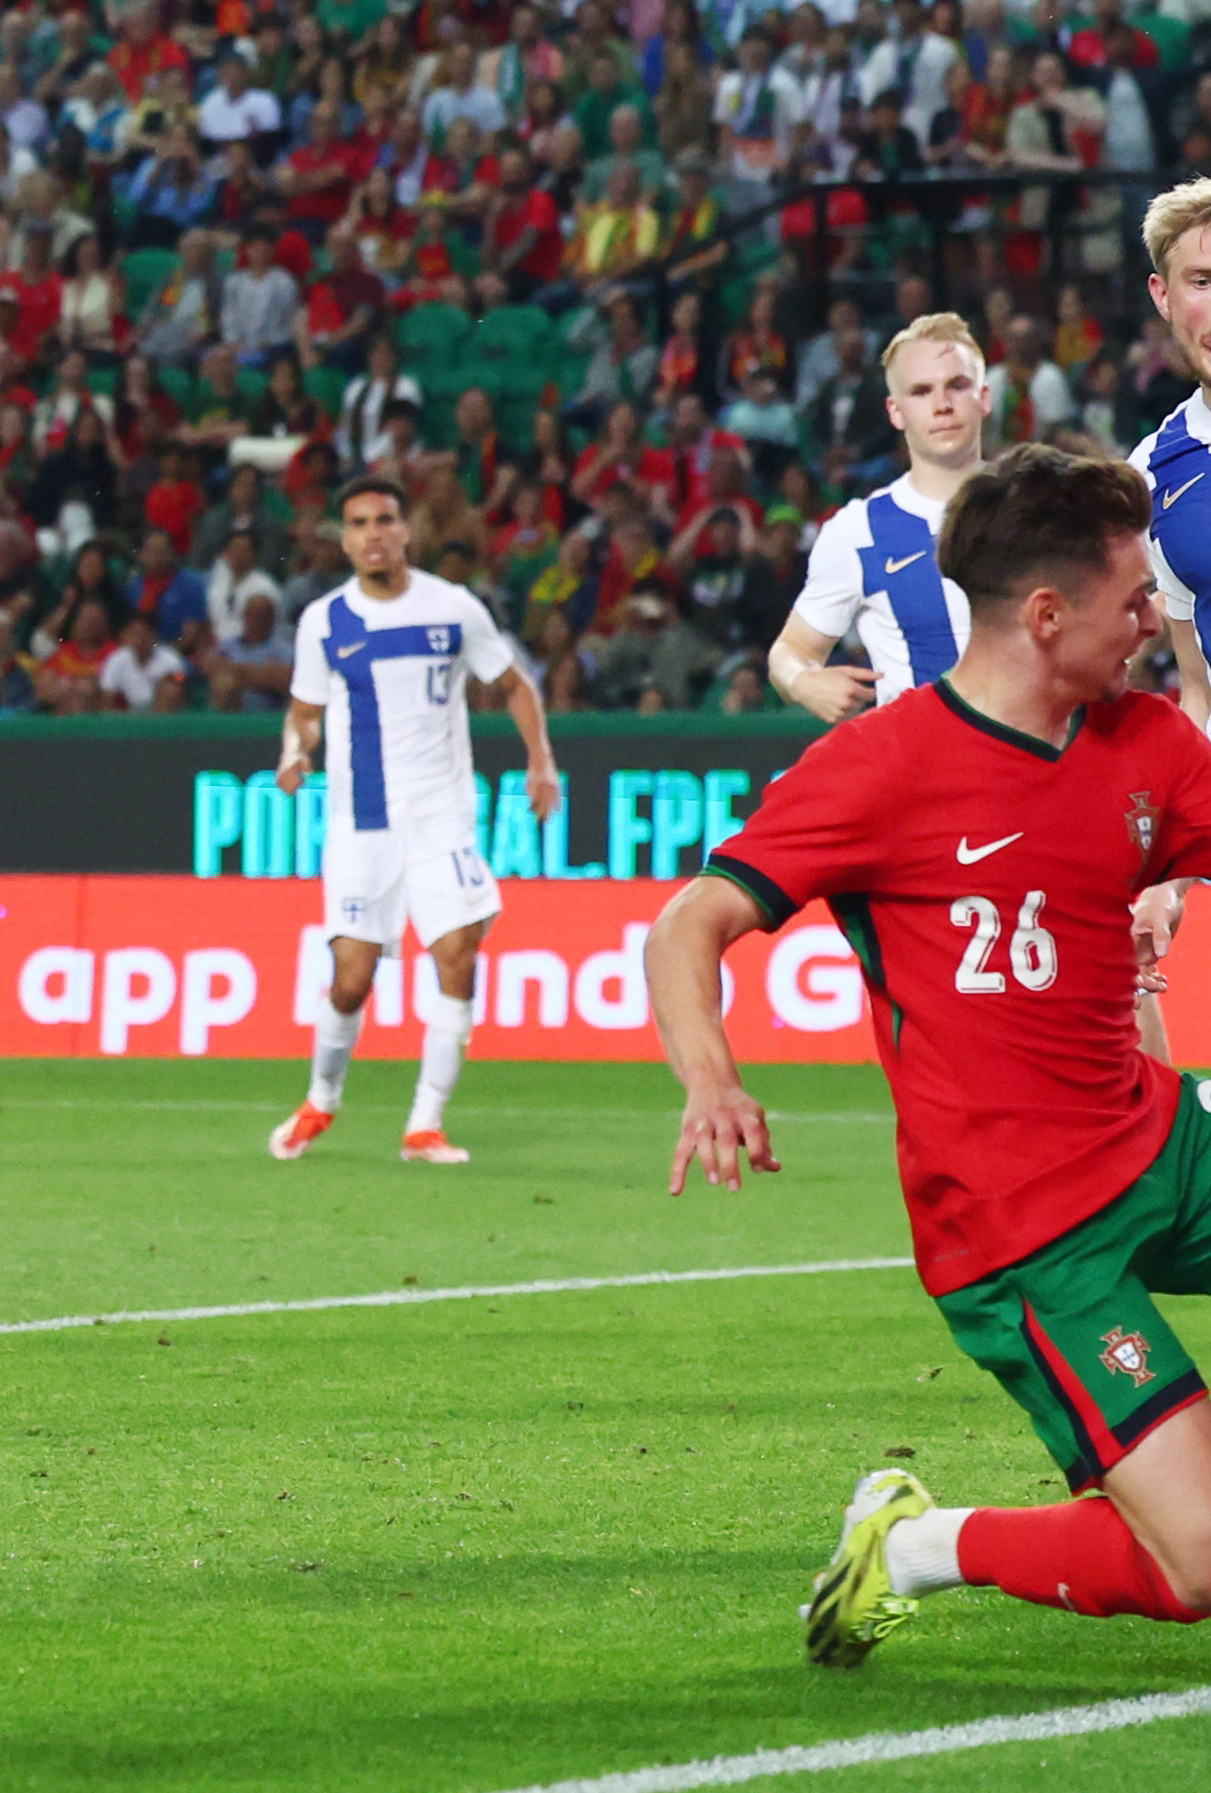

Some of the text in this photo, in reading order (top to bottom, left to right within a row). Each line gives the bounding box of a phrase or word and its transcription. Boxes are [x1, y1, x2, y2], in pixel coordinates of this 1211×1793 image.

[17, 946, 258, 1056] app
[293, 923, 735, 1029] Mund
[950, 889, 1058, 994] 26
